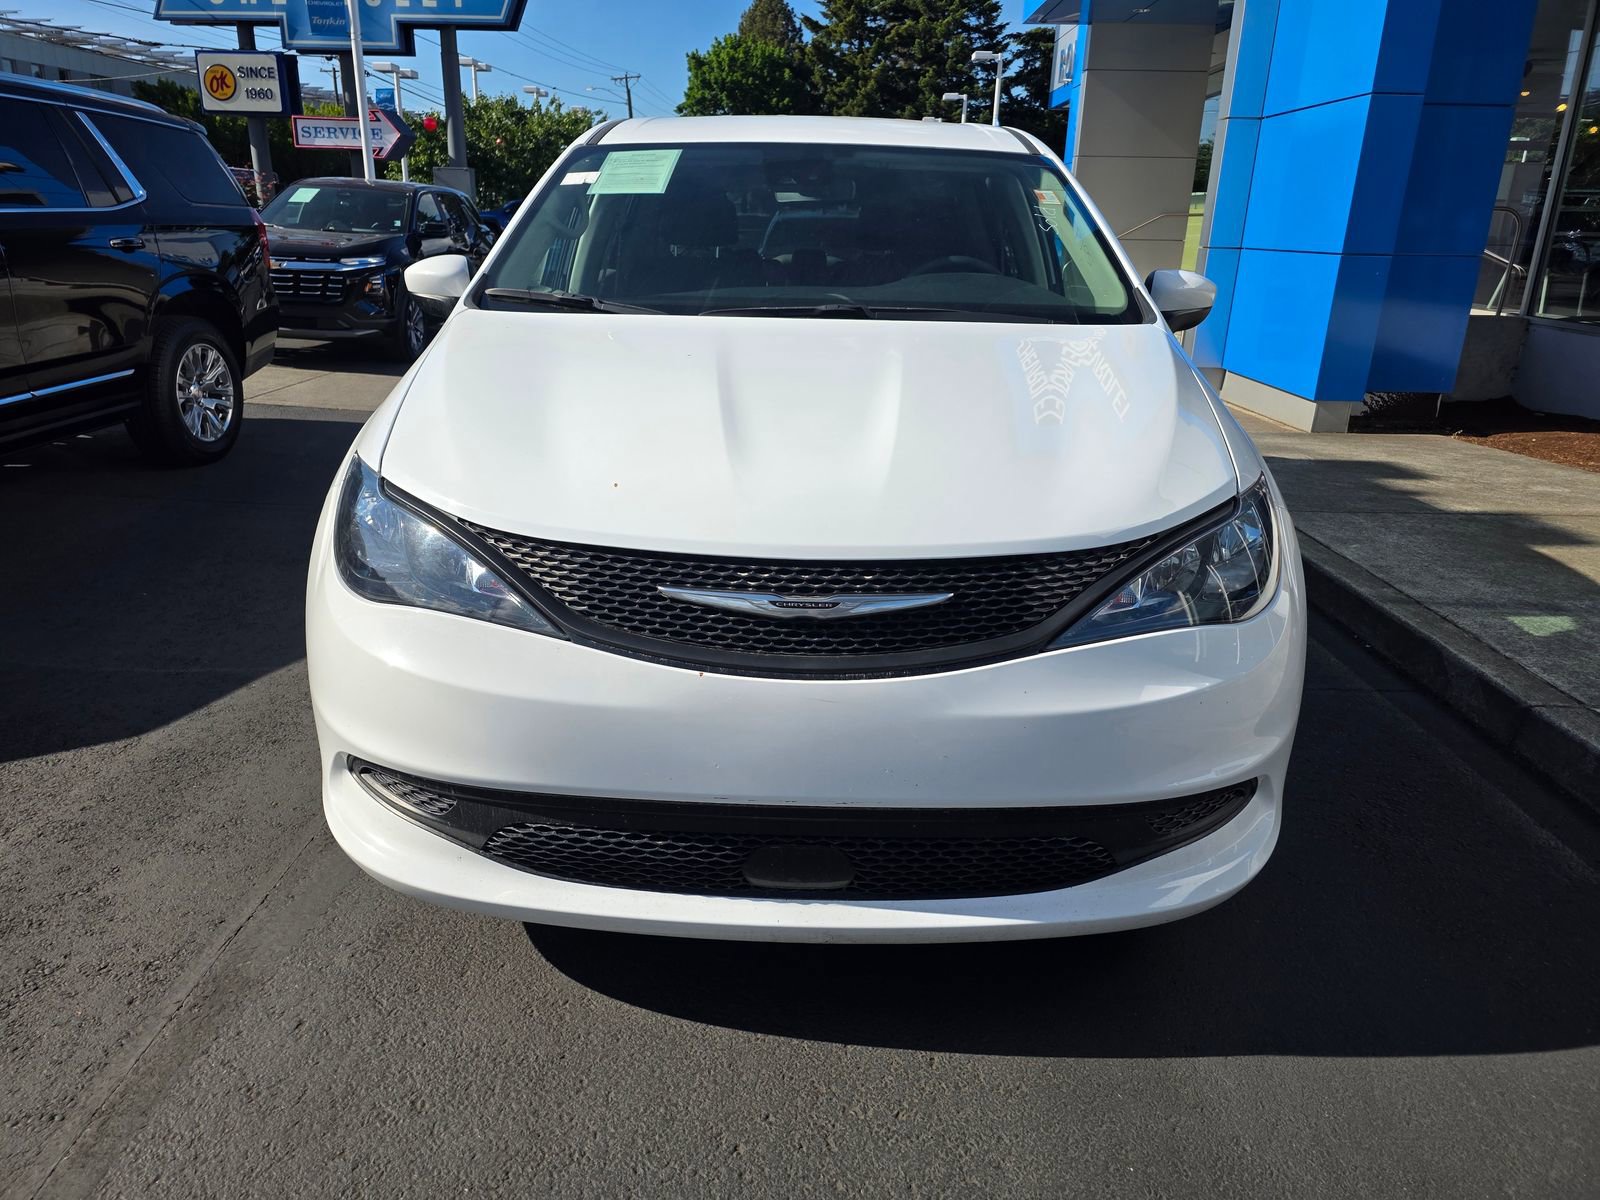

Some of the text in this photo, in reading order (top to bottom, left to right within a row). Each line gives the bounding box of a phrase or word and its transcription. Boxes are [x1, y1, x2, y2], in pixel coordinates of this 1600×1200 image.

[312, 16, 346, 25] Tonkin
[237, 66, 276, 79] SINCE
[209, 70, 232, 94] OK
[245, 88, 273, 100] 1960
[301, 126, 383, 141] SERVIE
